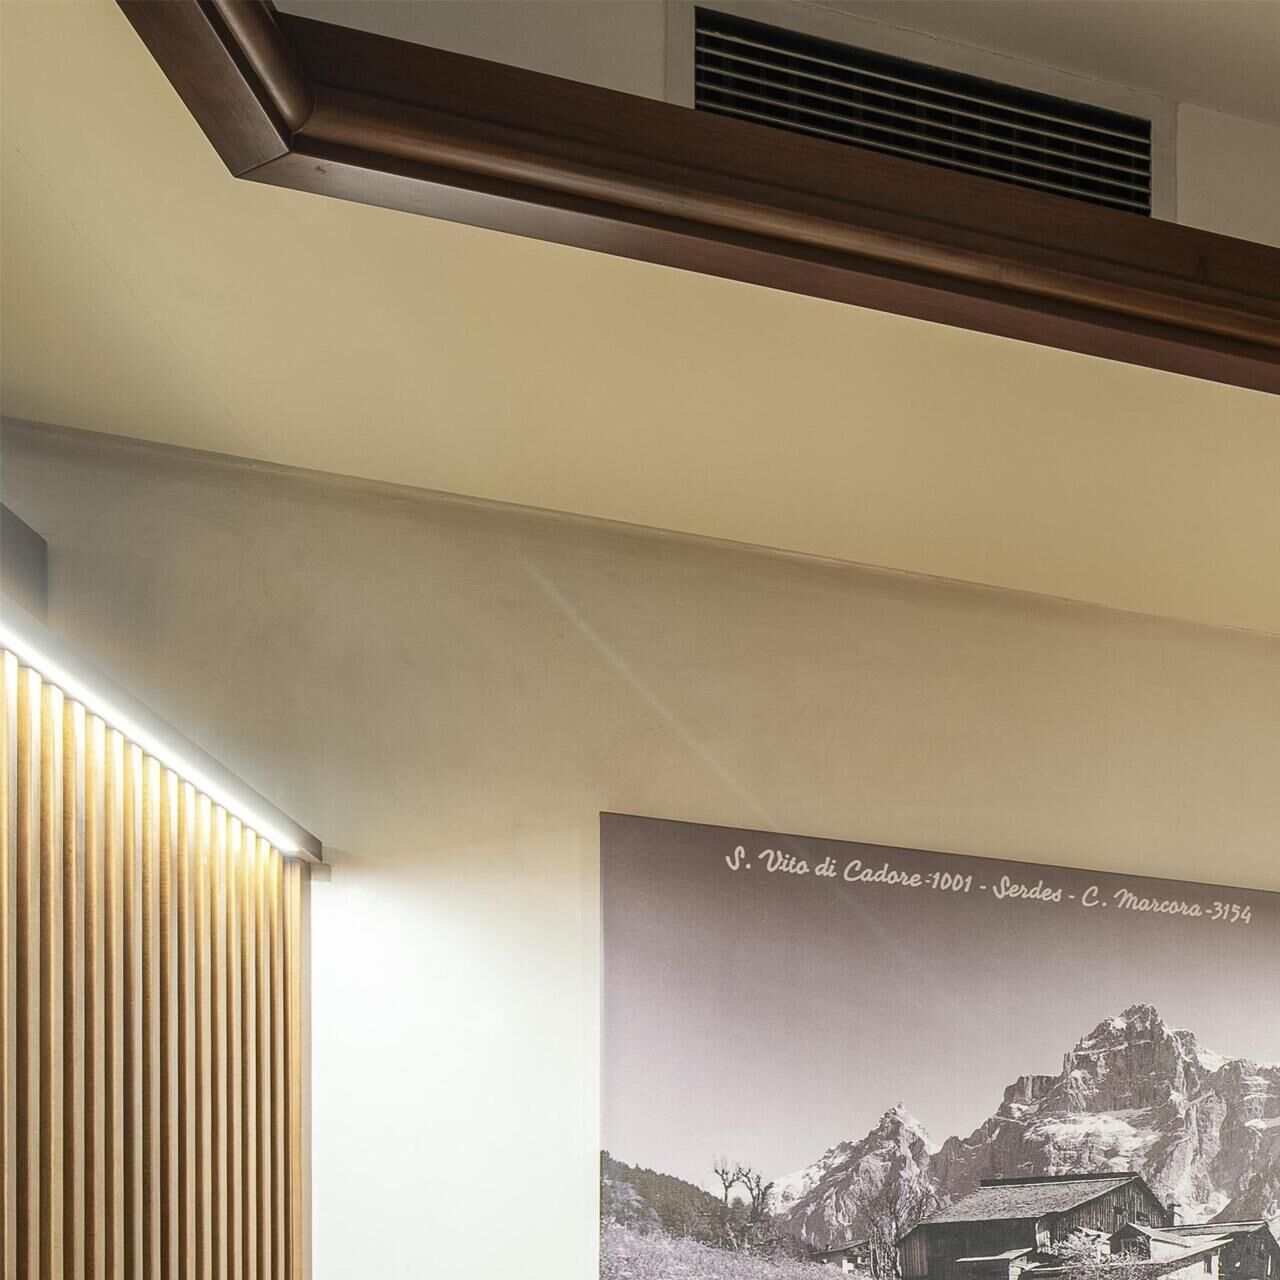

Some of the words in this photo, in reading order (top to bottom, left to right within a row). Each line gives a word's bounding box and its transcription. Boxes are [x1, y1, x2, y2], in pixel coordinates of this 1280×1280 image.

[726, 846, 751, 870] S.
[759, 849, 810, 874] Vito
[816, 857, 836, 877] di
[844, 860, 921, 887] Cadore
[993, 876, 1061, 901] Serdes
[1082, 886, 1106, 907] C.
[1114, 889, 1201, 917] Marcora
